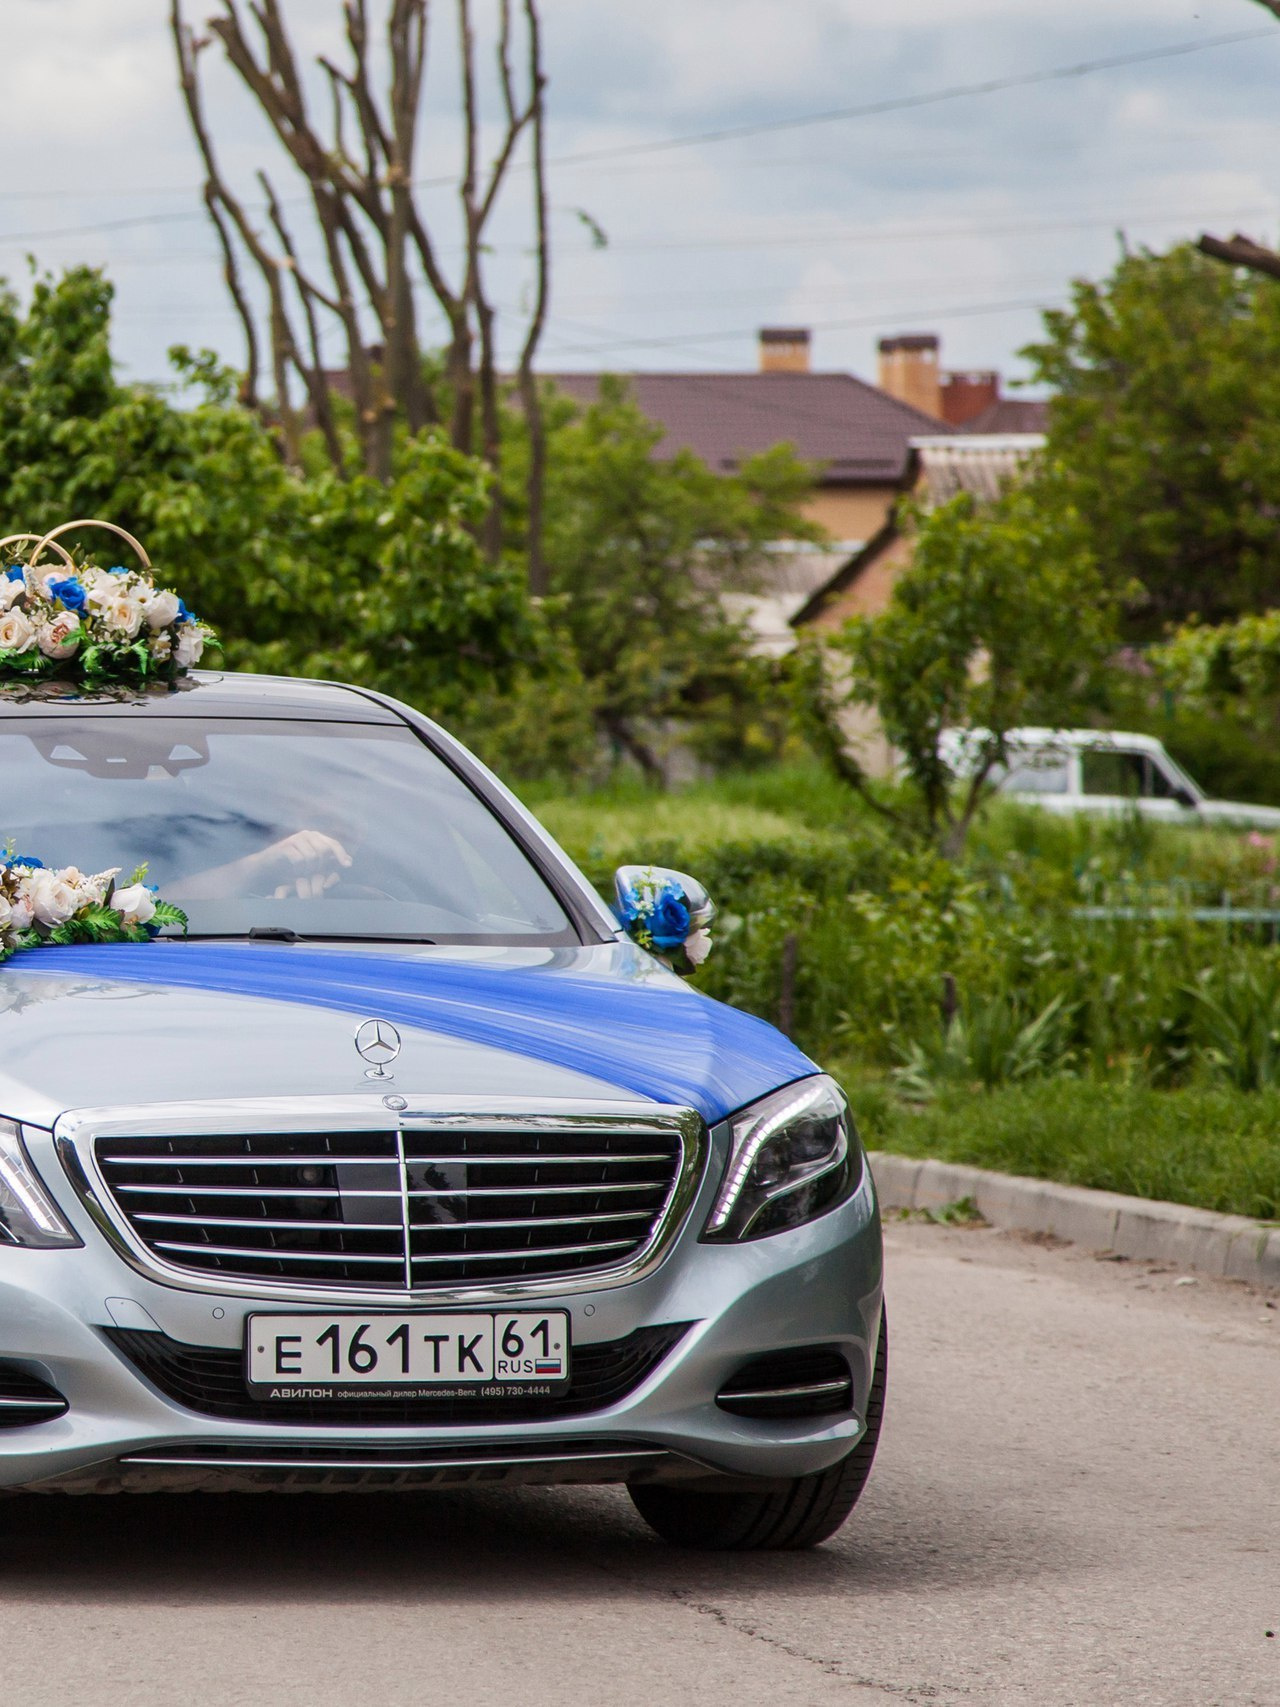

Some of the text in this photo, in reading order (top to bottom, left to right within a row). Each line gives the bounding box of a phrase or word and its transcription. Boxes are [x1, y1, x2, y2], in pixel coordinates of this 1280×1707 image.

[501, 1319, 550, 1357] 61
[497, 1360, 534, 1374] RUS
[269, 1387, 333, 1399] АВИЛОН
[392, 1390, 418, 1400] дилер
[417, 1388, 477, 1398] Mercedes-Benz
[480, 1387, 505, 1397] (495)
[506, 1386, 551, 1396] 730-4444
